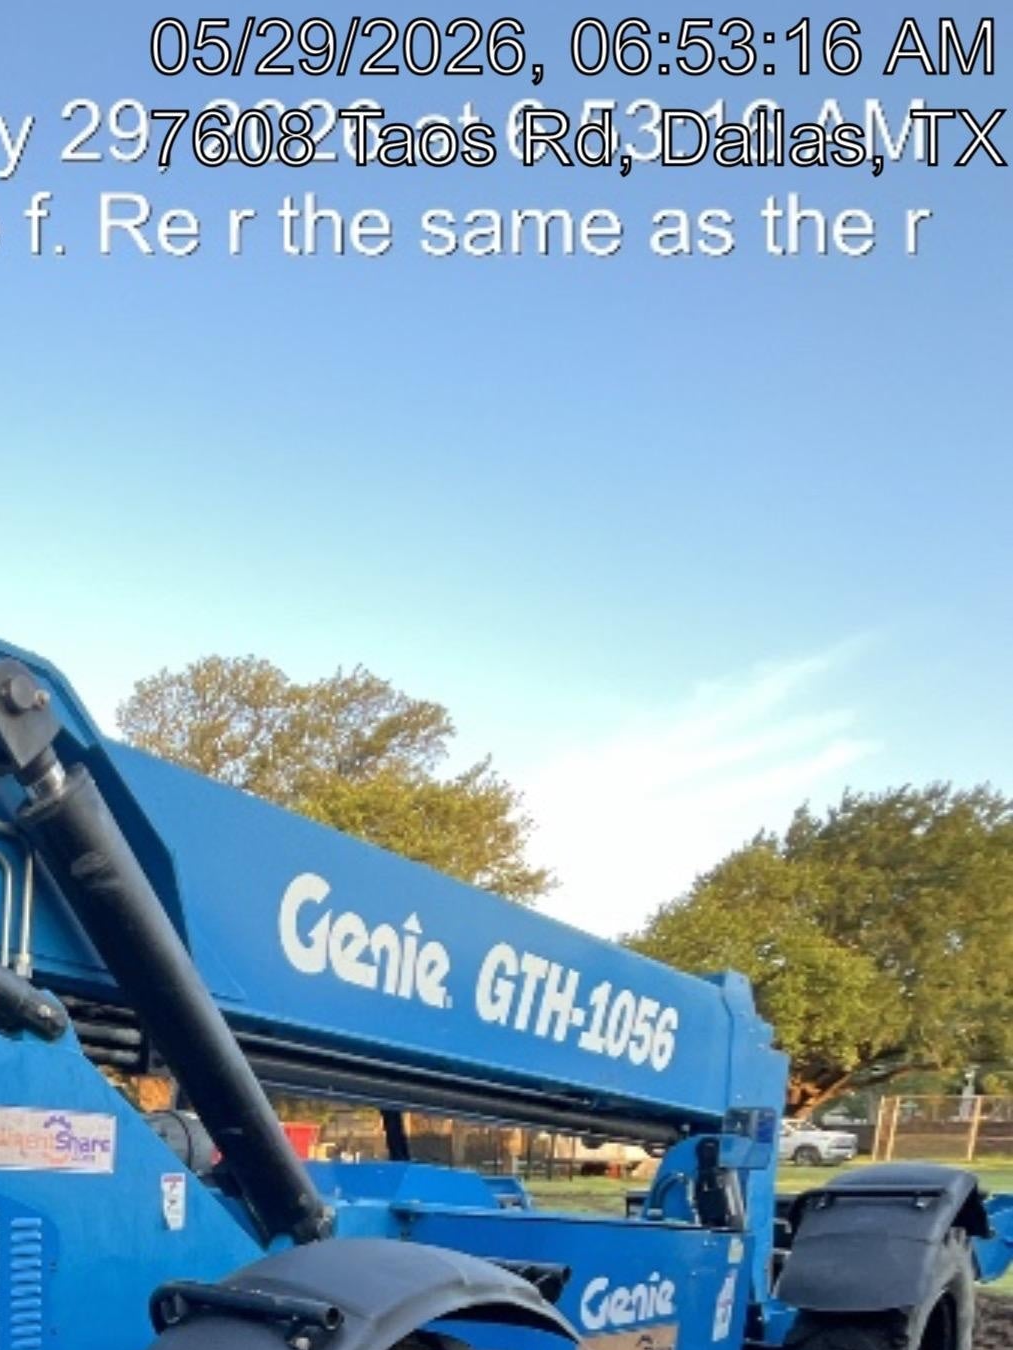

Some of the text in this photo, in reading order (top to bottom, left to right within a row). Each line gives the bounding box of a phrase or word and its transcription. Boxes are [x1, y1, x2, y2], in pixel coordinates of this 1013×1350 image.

[278, 872, 679, 1072] Genie GTH-1056
[580, 1271, 676, 1330] Genie
